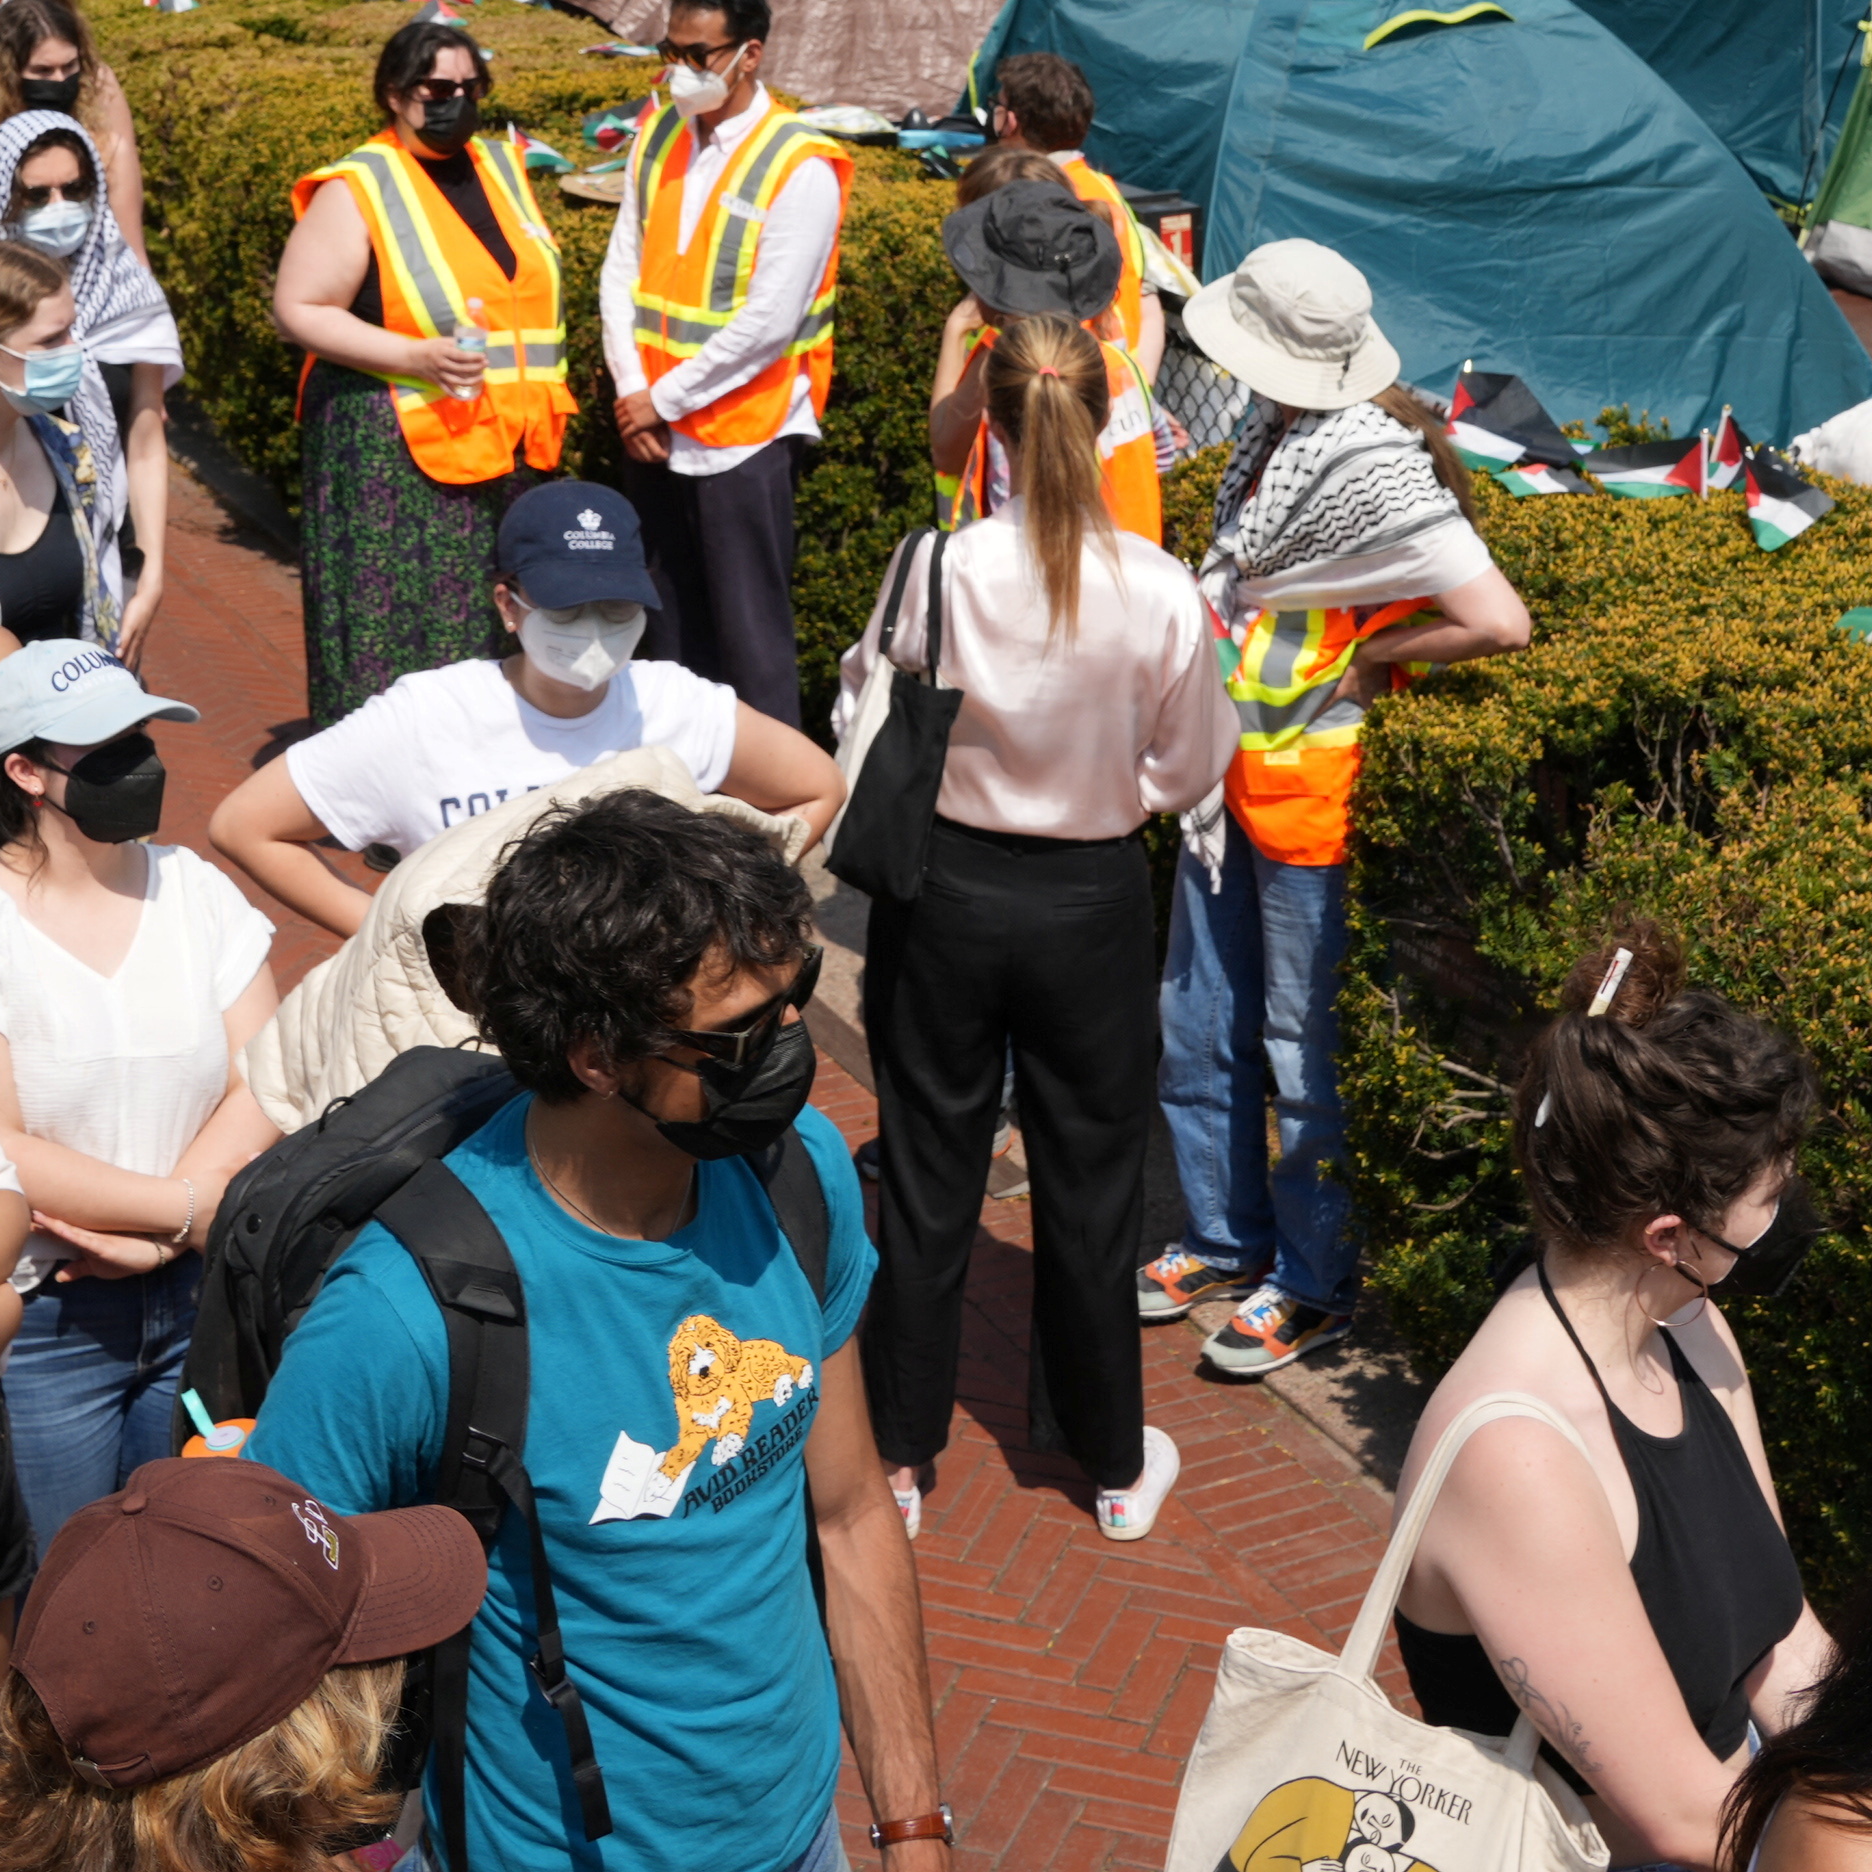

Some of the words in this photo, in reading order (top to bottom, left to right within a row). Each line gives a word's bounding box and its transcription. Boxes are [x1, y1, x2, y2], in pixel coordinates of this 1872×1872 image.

[563, 530, 616, 541] COLUMBIA
[568, 540, 614, 550] COLLEGE
[683, 1461, 738, 1519] AVID
[739, 1386, 819, 1471] READER
[711, 1426, 803, 1514] BOOKSTORE
[1335, 1739, 1387, 1781] NEW
[1388, 1769, 1473, 1826] YORKER
[1399, 1758, 1423, 1776] THE
